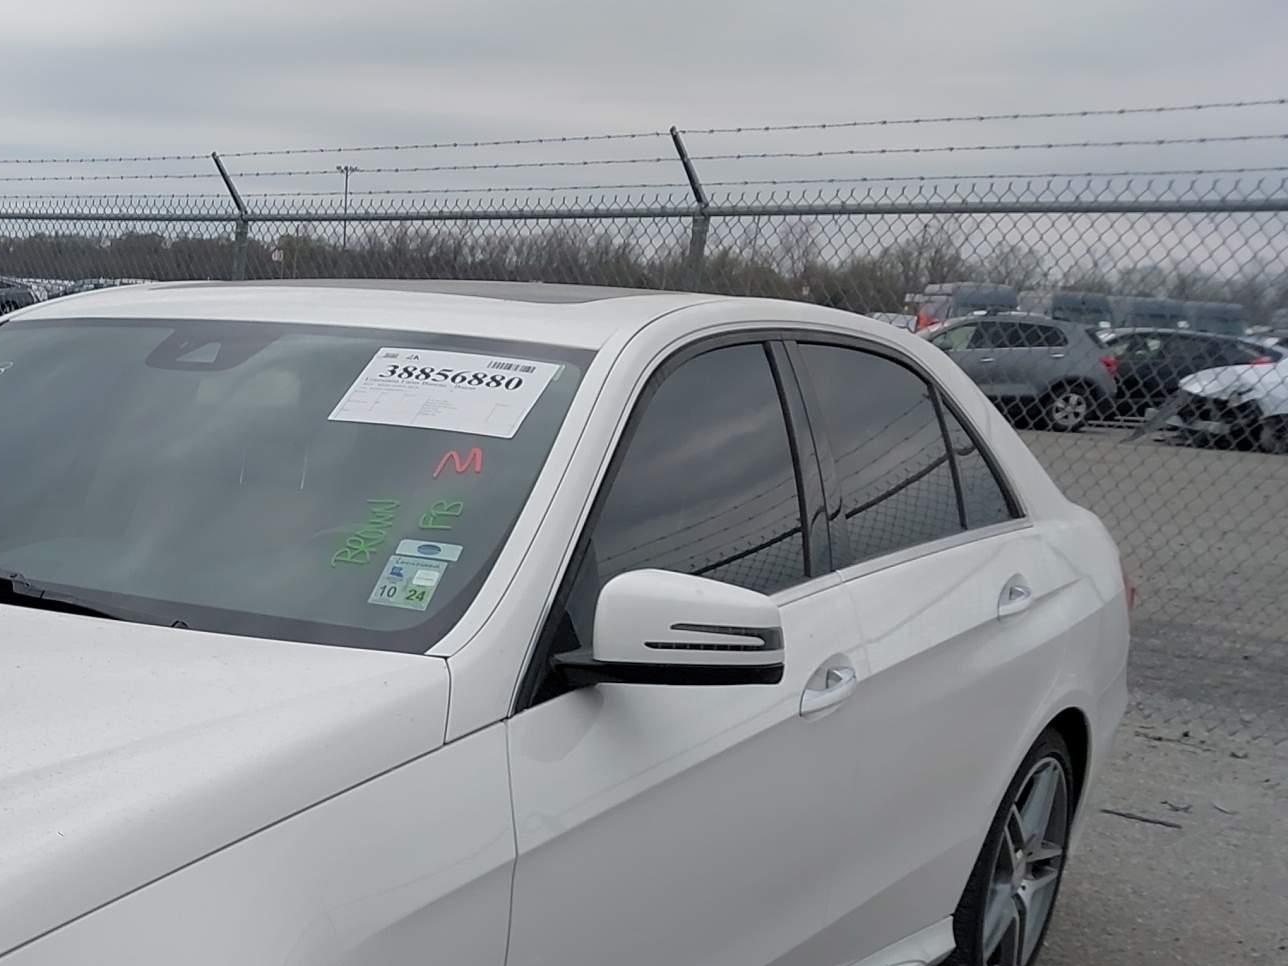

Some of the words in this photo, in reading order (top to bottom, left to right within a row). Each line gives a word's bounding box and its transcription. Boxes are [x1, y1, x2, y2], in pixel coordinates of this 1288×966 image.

[378, 364, 523, 391] 38856880
[433, 448, 483, 478] M
[379, 584, 397, 598] 10
[405, 589, 426, 602] 24
